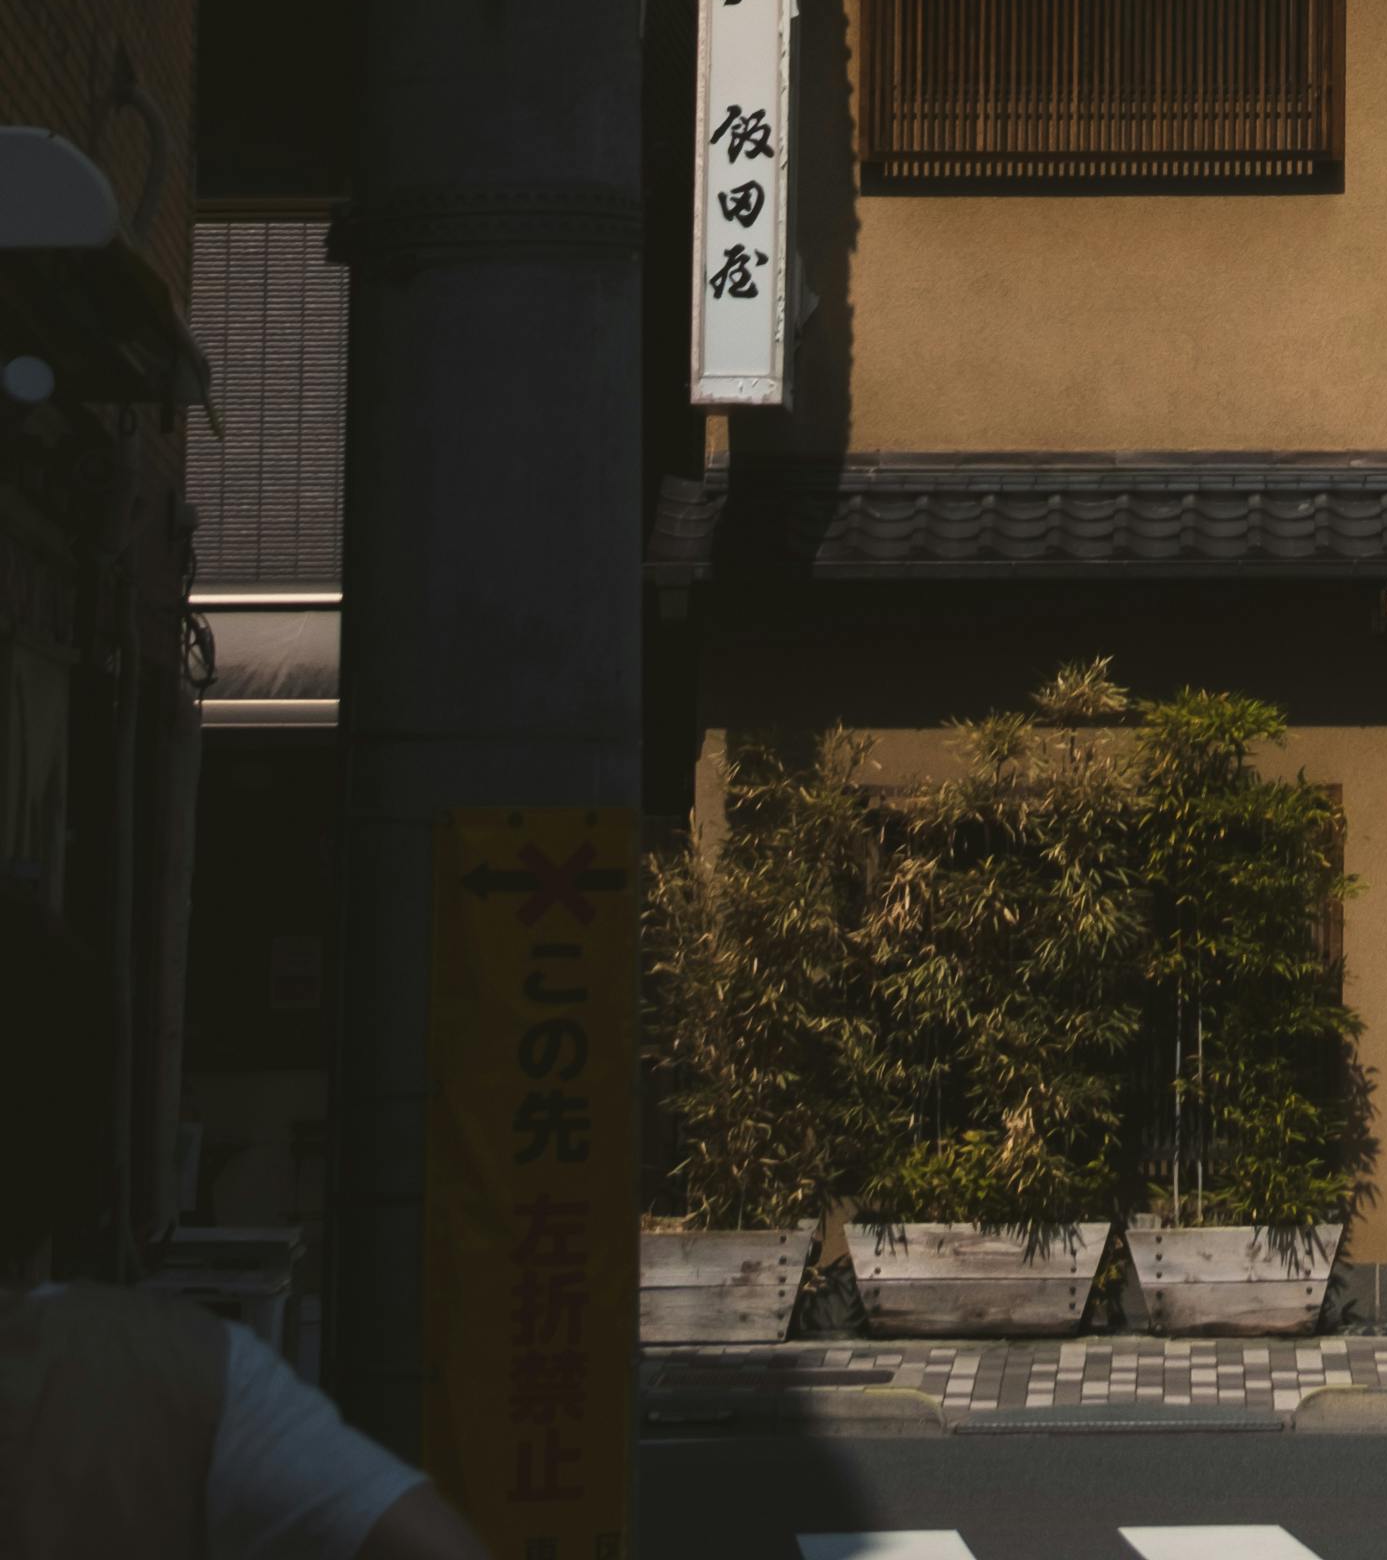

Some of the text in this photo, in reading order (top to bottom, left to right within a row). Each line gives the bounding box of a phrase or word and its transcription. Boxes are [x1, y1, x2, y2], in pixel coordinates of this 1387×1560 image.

[707, 104, 776, 301] 飯田屋
[512, 940, 592, 1168] この先
[507, 1192, 591, 1503] 左折禁止
